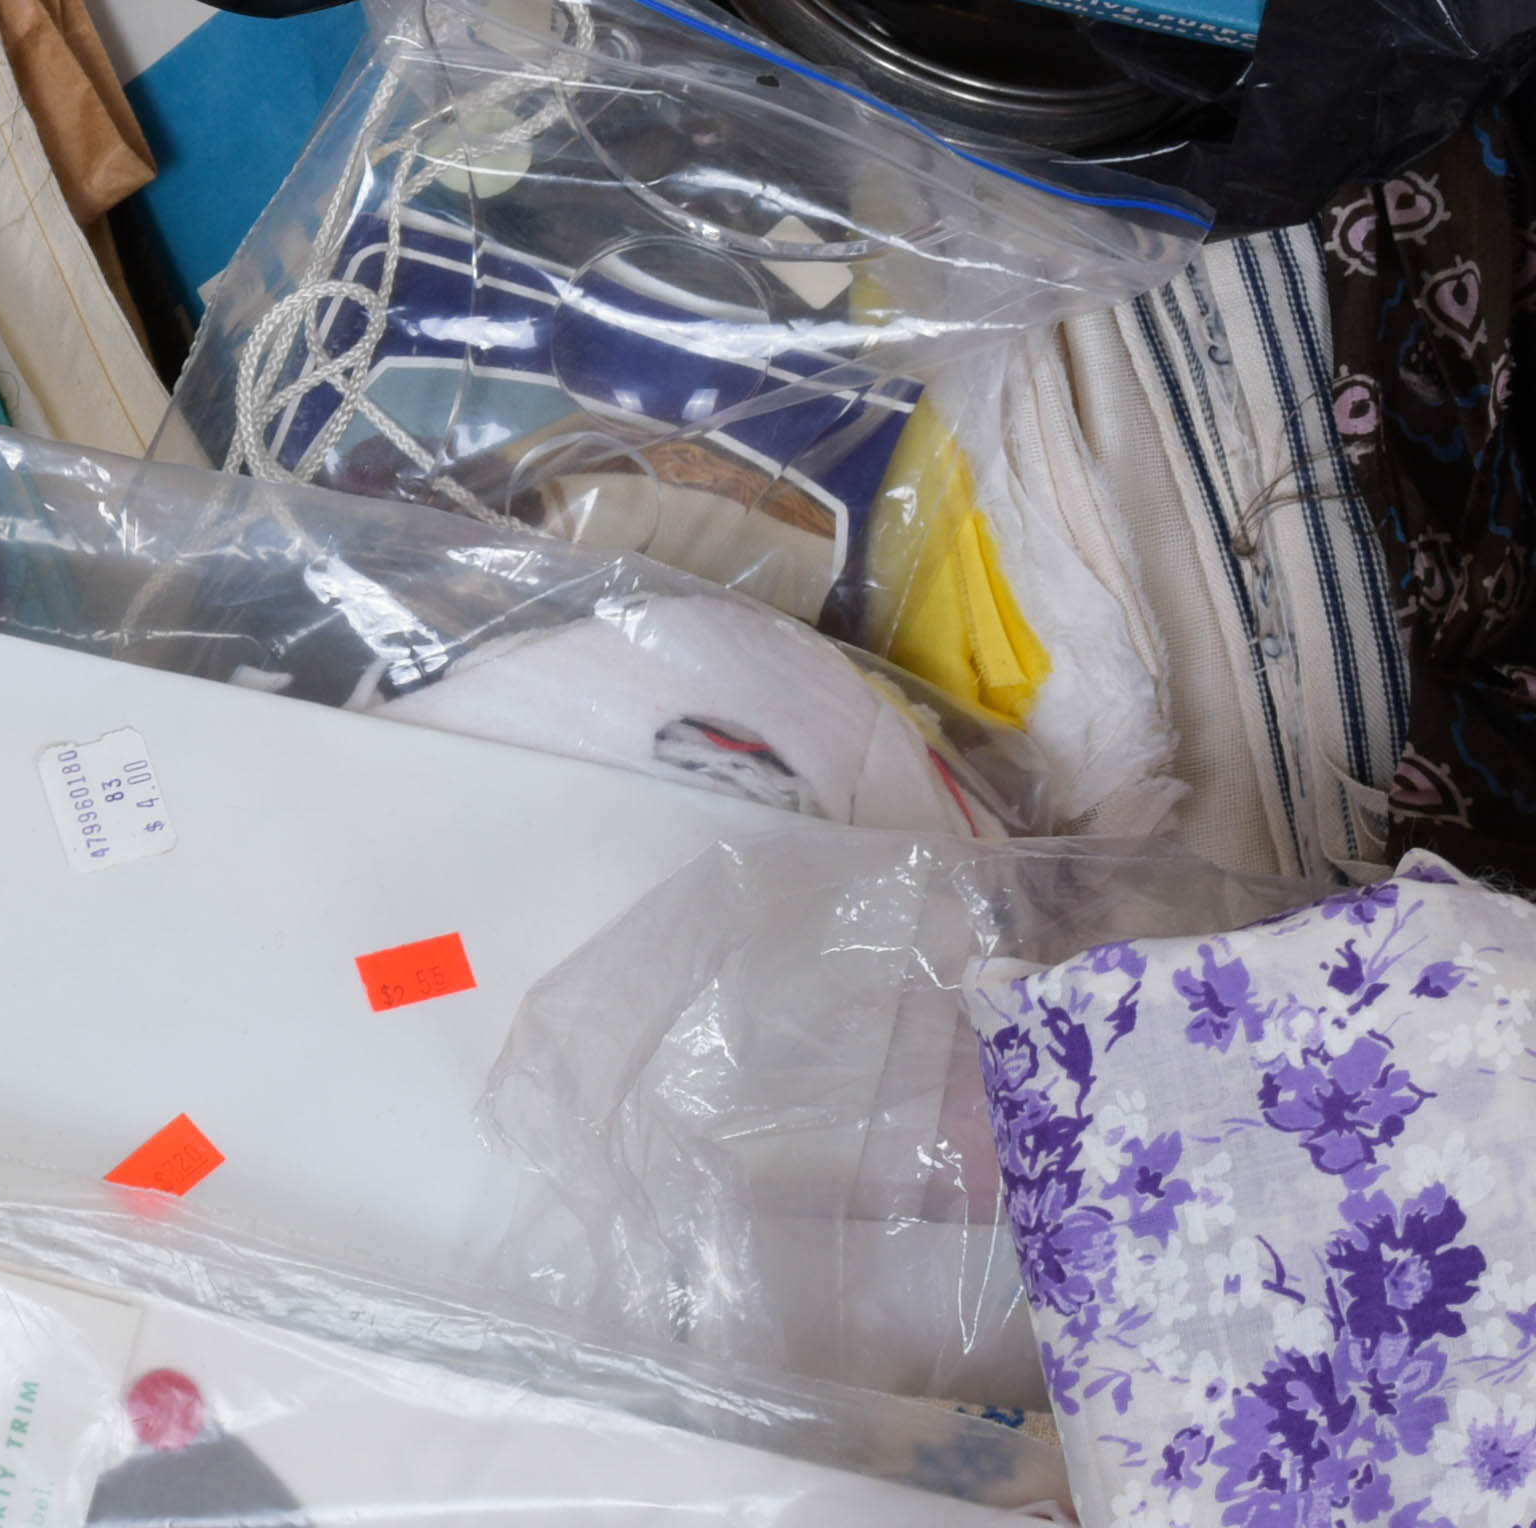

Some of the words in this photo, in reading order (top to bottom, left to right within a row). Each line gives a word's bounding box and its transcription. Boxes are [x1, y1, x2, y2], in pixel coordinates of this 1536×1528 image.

[57, 741, 112, 860] 479960180
[106, 777, 124, 804] 83
[123, 758, 158, 811] 4.00
[144, 820, 165, 833] $
[6, 1380, 41, 1450] TRIM
